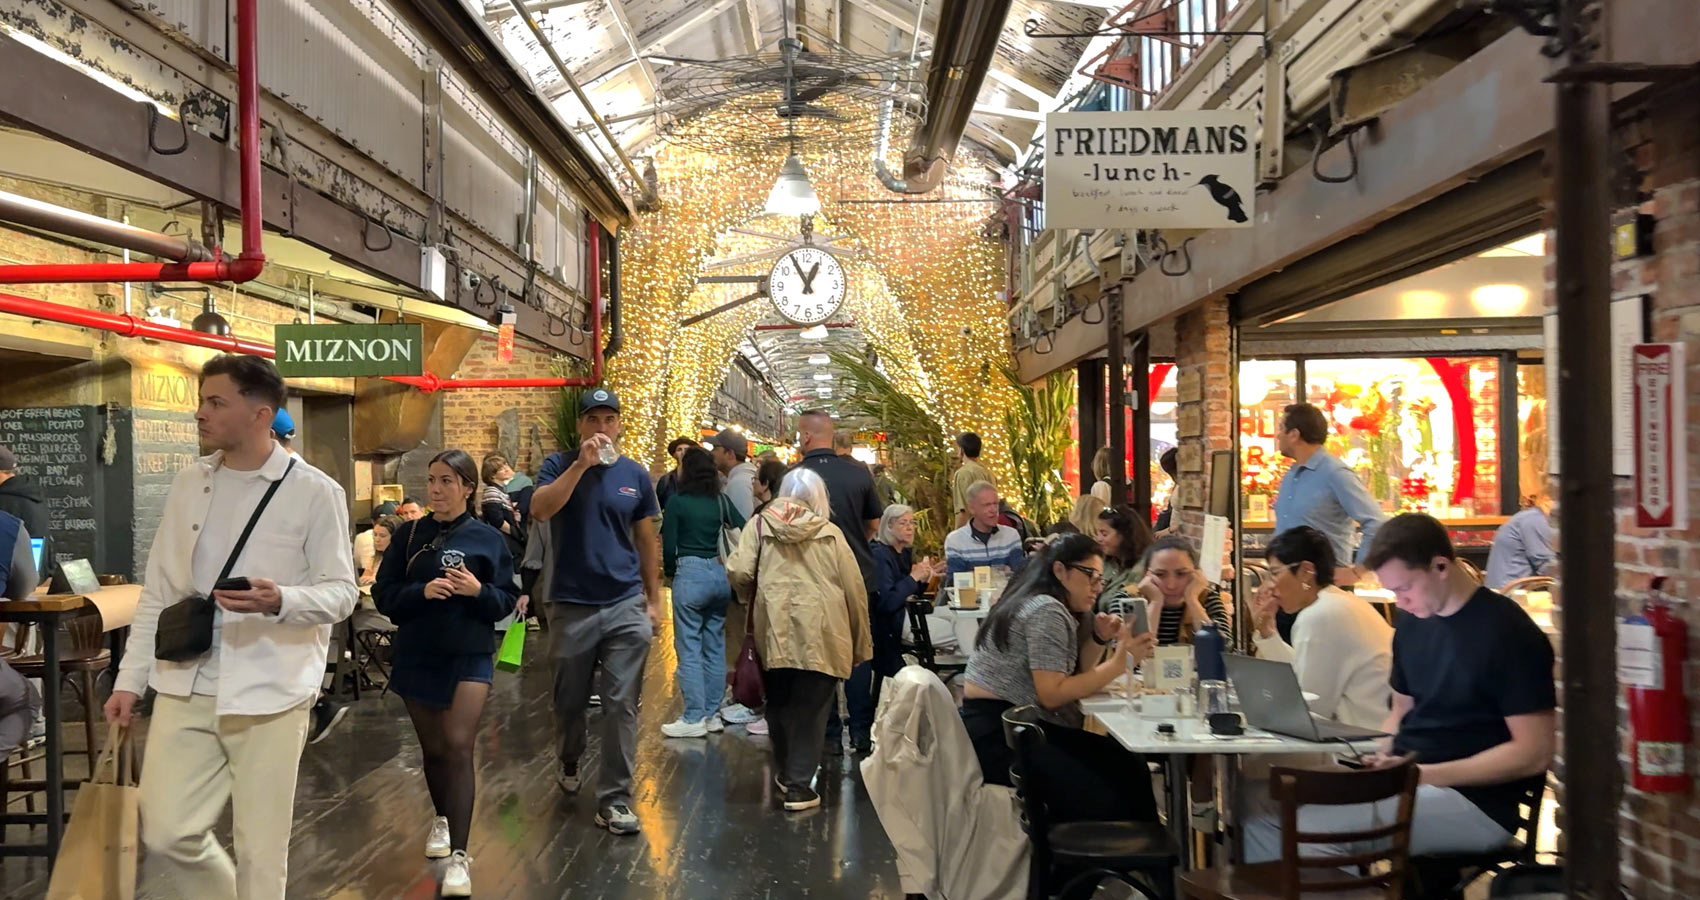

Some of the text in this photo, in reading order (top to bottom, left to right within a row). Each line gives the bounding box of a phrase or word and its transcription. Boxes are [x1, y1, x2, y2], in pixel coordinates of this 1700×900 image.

[1055, 125, 1248, 156] FRIEDMANS
[802, 253, 812, 264] 12
[781, 266, 790, 277] 10
[827, 265, 835, 275] 2
[777, 281, 784, 292] 9
[832, 280, 839, 290] 3
[781, 296, 789, 306] 8
[827, 295, 836, 305] 4
[794, 304, 801, 315] 7
[804, 307, 812, 318] 6
[816, 304, 824, 315] 5
[285, 338, 413, 363] MIZNON
[139, 374, 197, 406] MIZNON
[24, 408, 51, 419] GREEN
[52, 408, 81, 418] BEANS
[48, 420, 84, 430] POTATO
[20, 432, 79, 443] MUSHROOMS
[40, 443, 81, 454] BURGER
[16, 453, 87, 464] RIGINAL WORLD
[64, 518, 97, 530] BURGER
